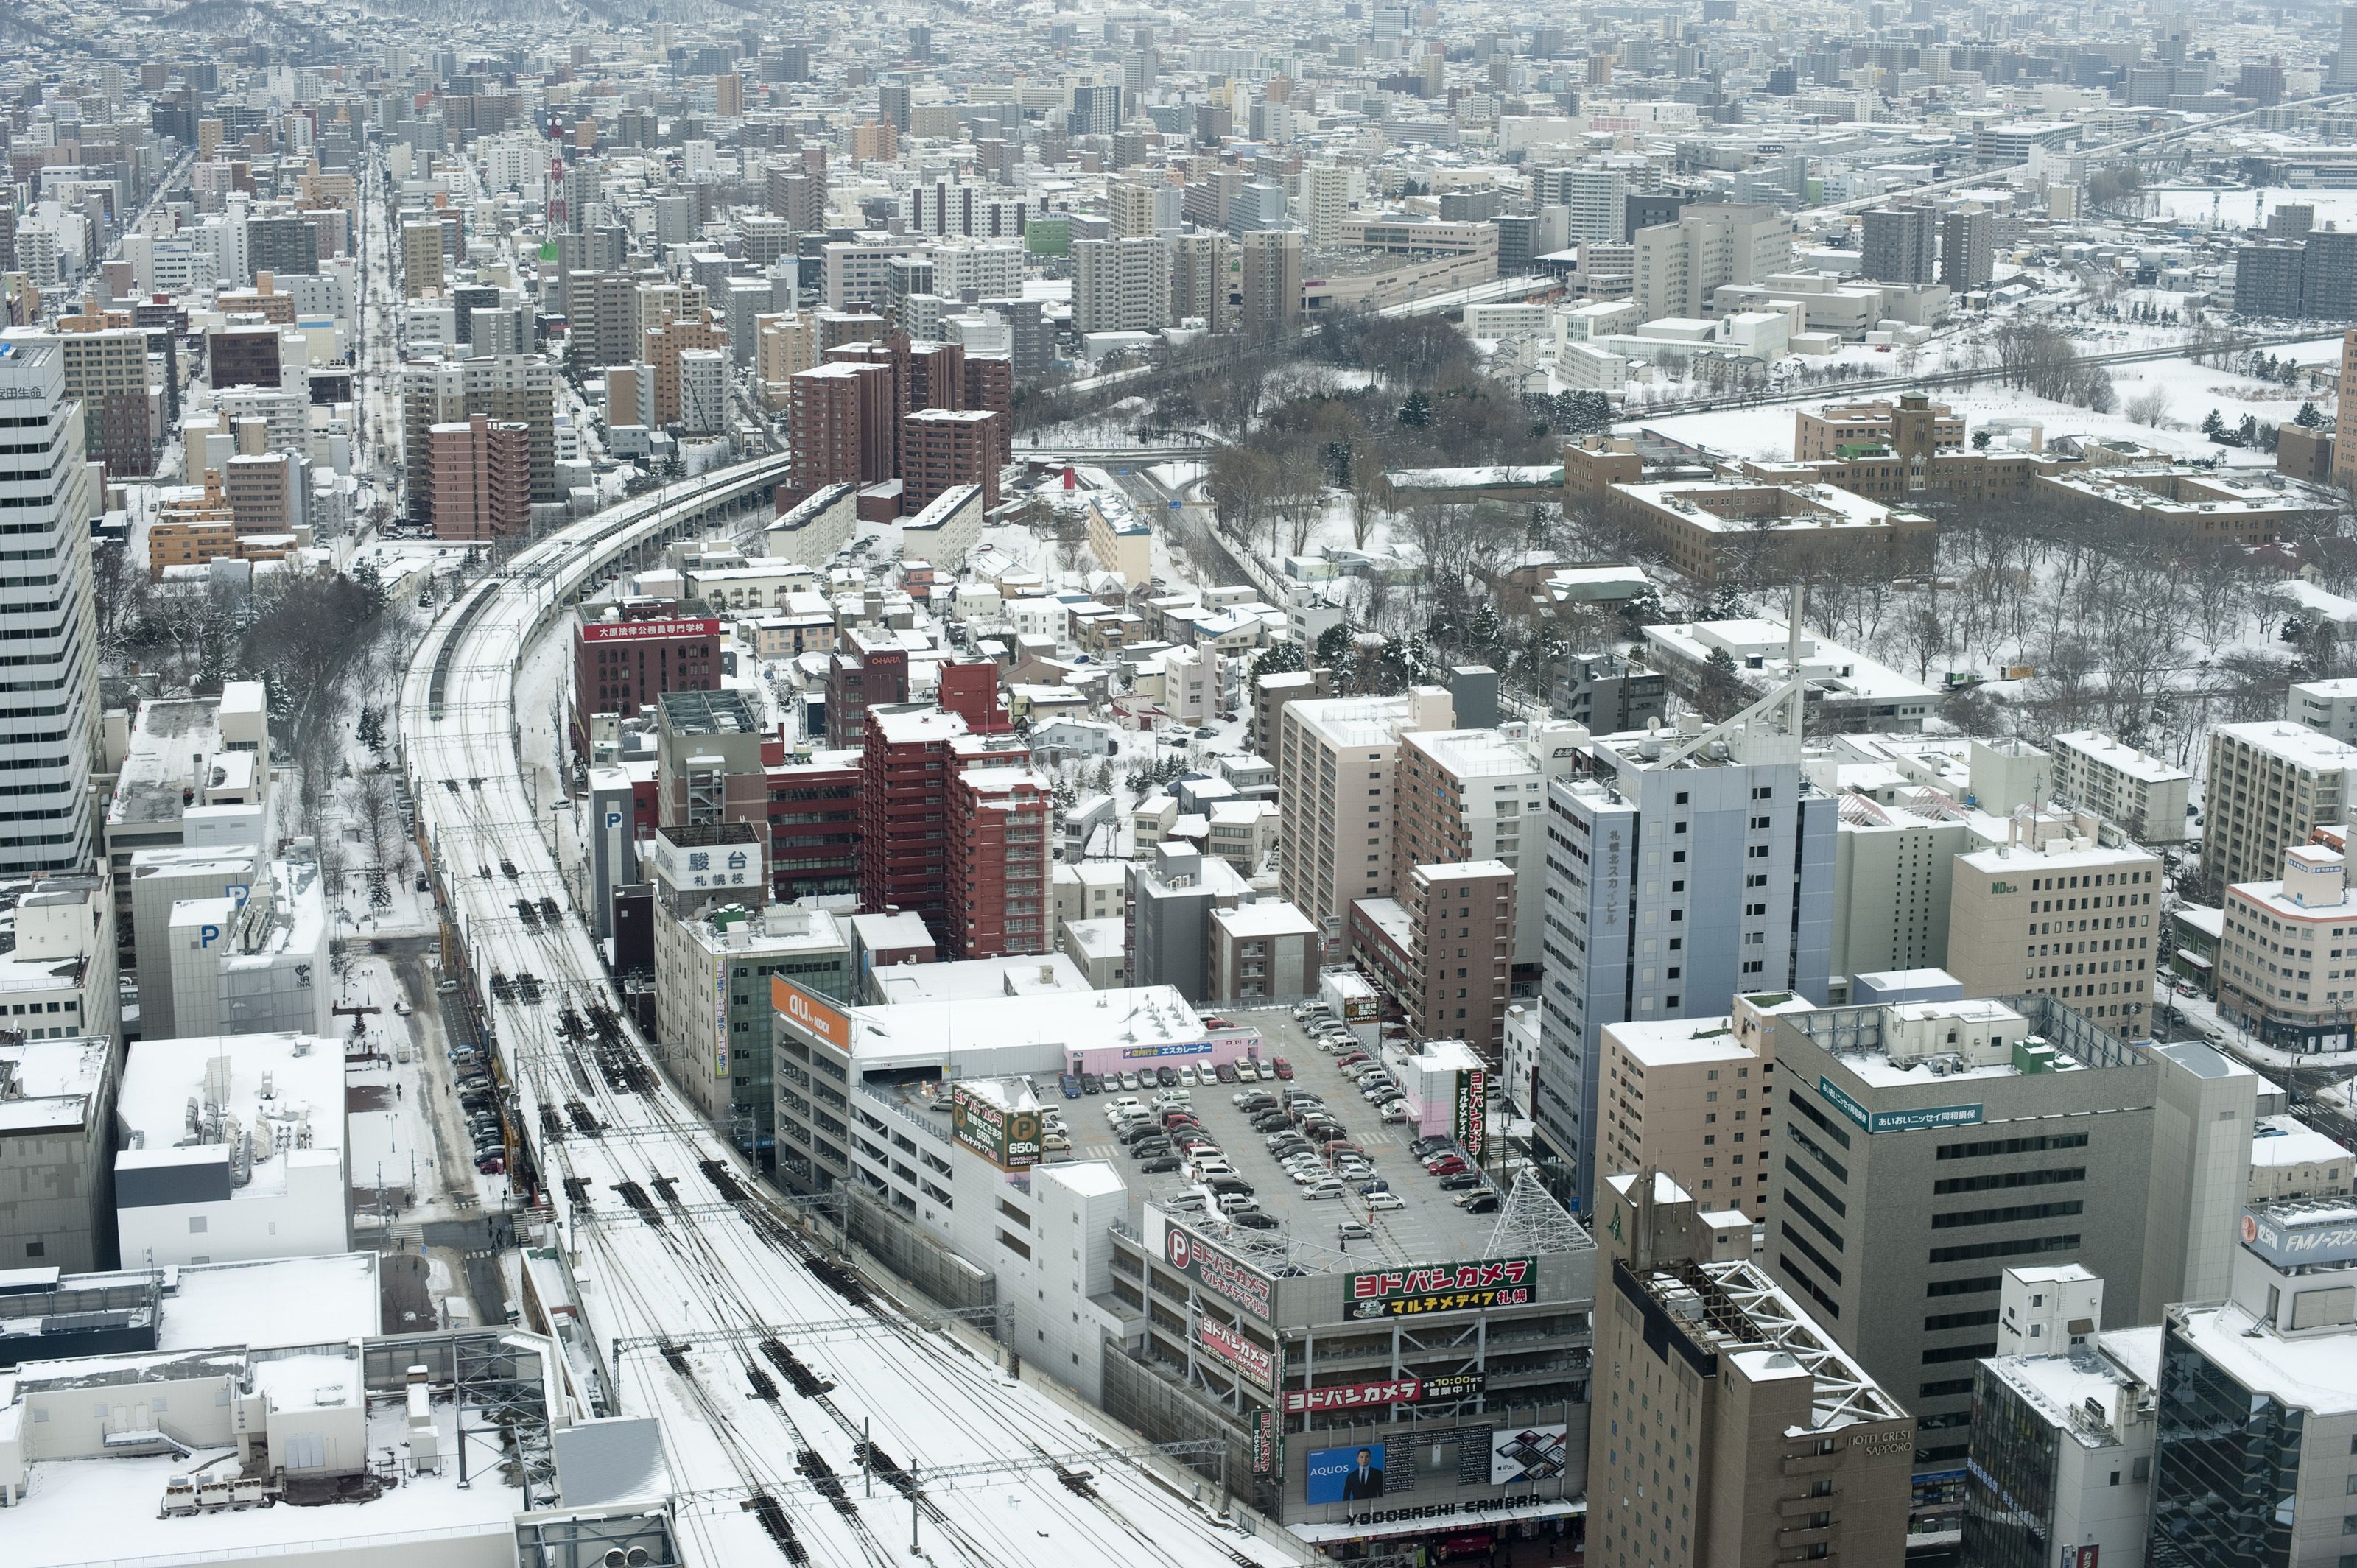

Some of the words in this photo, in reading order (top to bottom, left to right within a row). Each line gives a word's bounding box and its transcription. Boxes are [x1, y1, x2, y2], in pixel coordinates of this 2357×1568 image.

[600, 623, 705, 637] 大原法律公務員専門学校
[607, 813, 622, 828] P
[689, 851, 748, 872] 駿台
[694, 873, 745, 886] 札幌校
[1606, 830, 1620, 924] 札幌北スカイビル
[229, 887, 247, 899] P
[202, 925, 219, 949] P
[790, 994, 808, 1022] au
[814, 1016, 829, 1035] KDDI
[1162, 1045, 1212, 1055] エスカレーター
[1469, 1072, 1483, 1155] ヨドバシカメラ
[1878, 1110, 1976, 1126] あいおいニッセイ同和損保
[1008, 1142, 1039, 1154] 650台
[1173, 1233, 1186, 1262] P
[2285, 1228, 2357, 1252] FMノースウ
[1192, 1238, 1269, 1301] ヨドバシカメラ
[1354, 1261, 1528, 1298] ヨドバシカメラ
[1391, 1289, 1528, 1314] マルチメディア札幌
[1203, 1317, 1268, 1368] ヨドバシカメラ
[1422, 1376, 1483, 1388] よる10:00まで
[1288, 1382, 1416, 1410] ヨドバシカメラ
[1260, 1413, 1270, 1472] ヨドバシカメラ
[1848, 1434, 1879, 1446] HOTEL
[1882, 1430, 1912, 1441] CREST
[1866, 1442, 1912, 1456] SAPPORO
[1310, 1465, 1349, 1476] AQUOS
[1346, 1502, 1455, 1526] YODOBASHI
[1464, 1494, 1540, 1513] CAMERA
